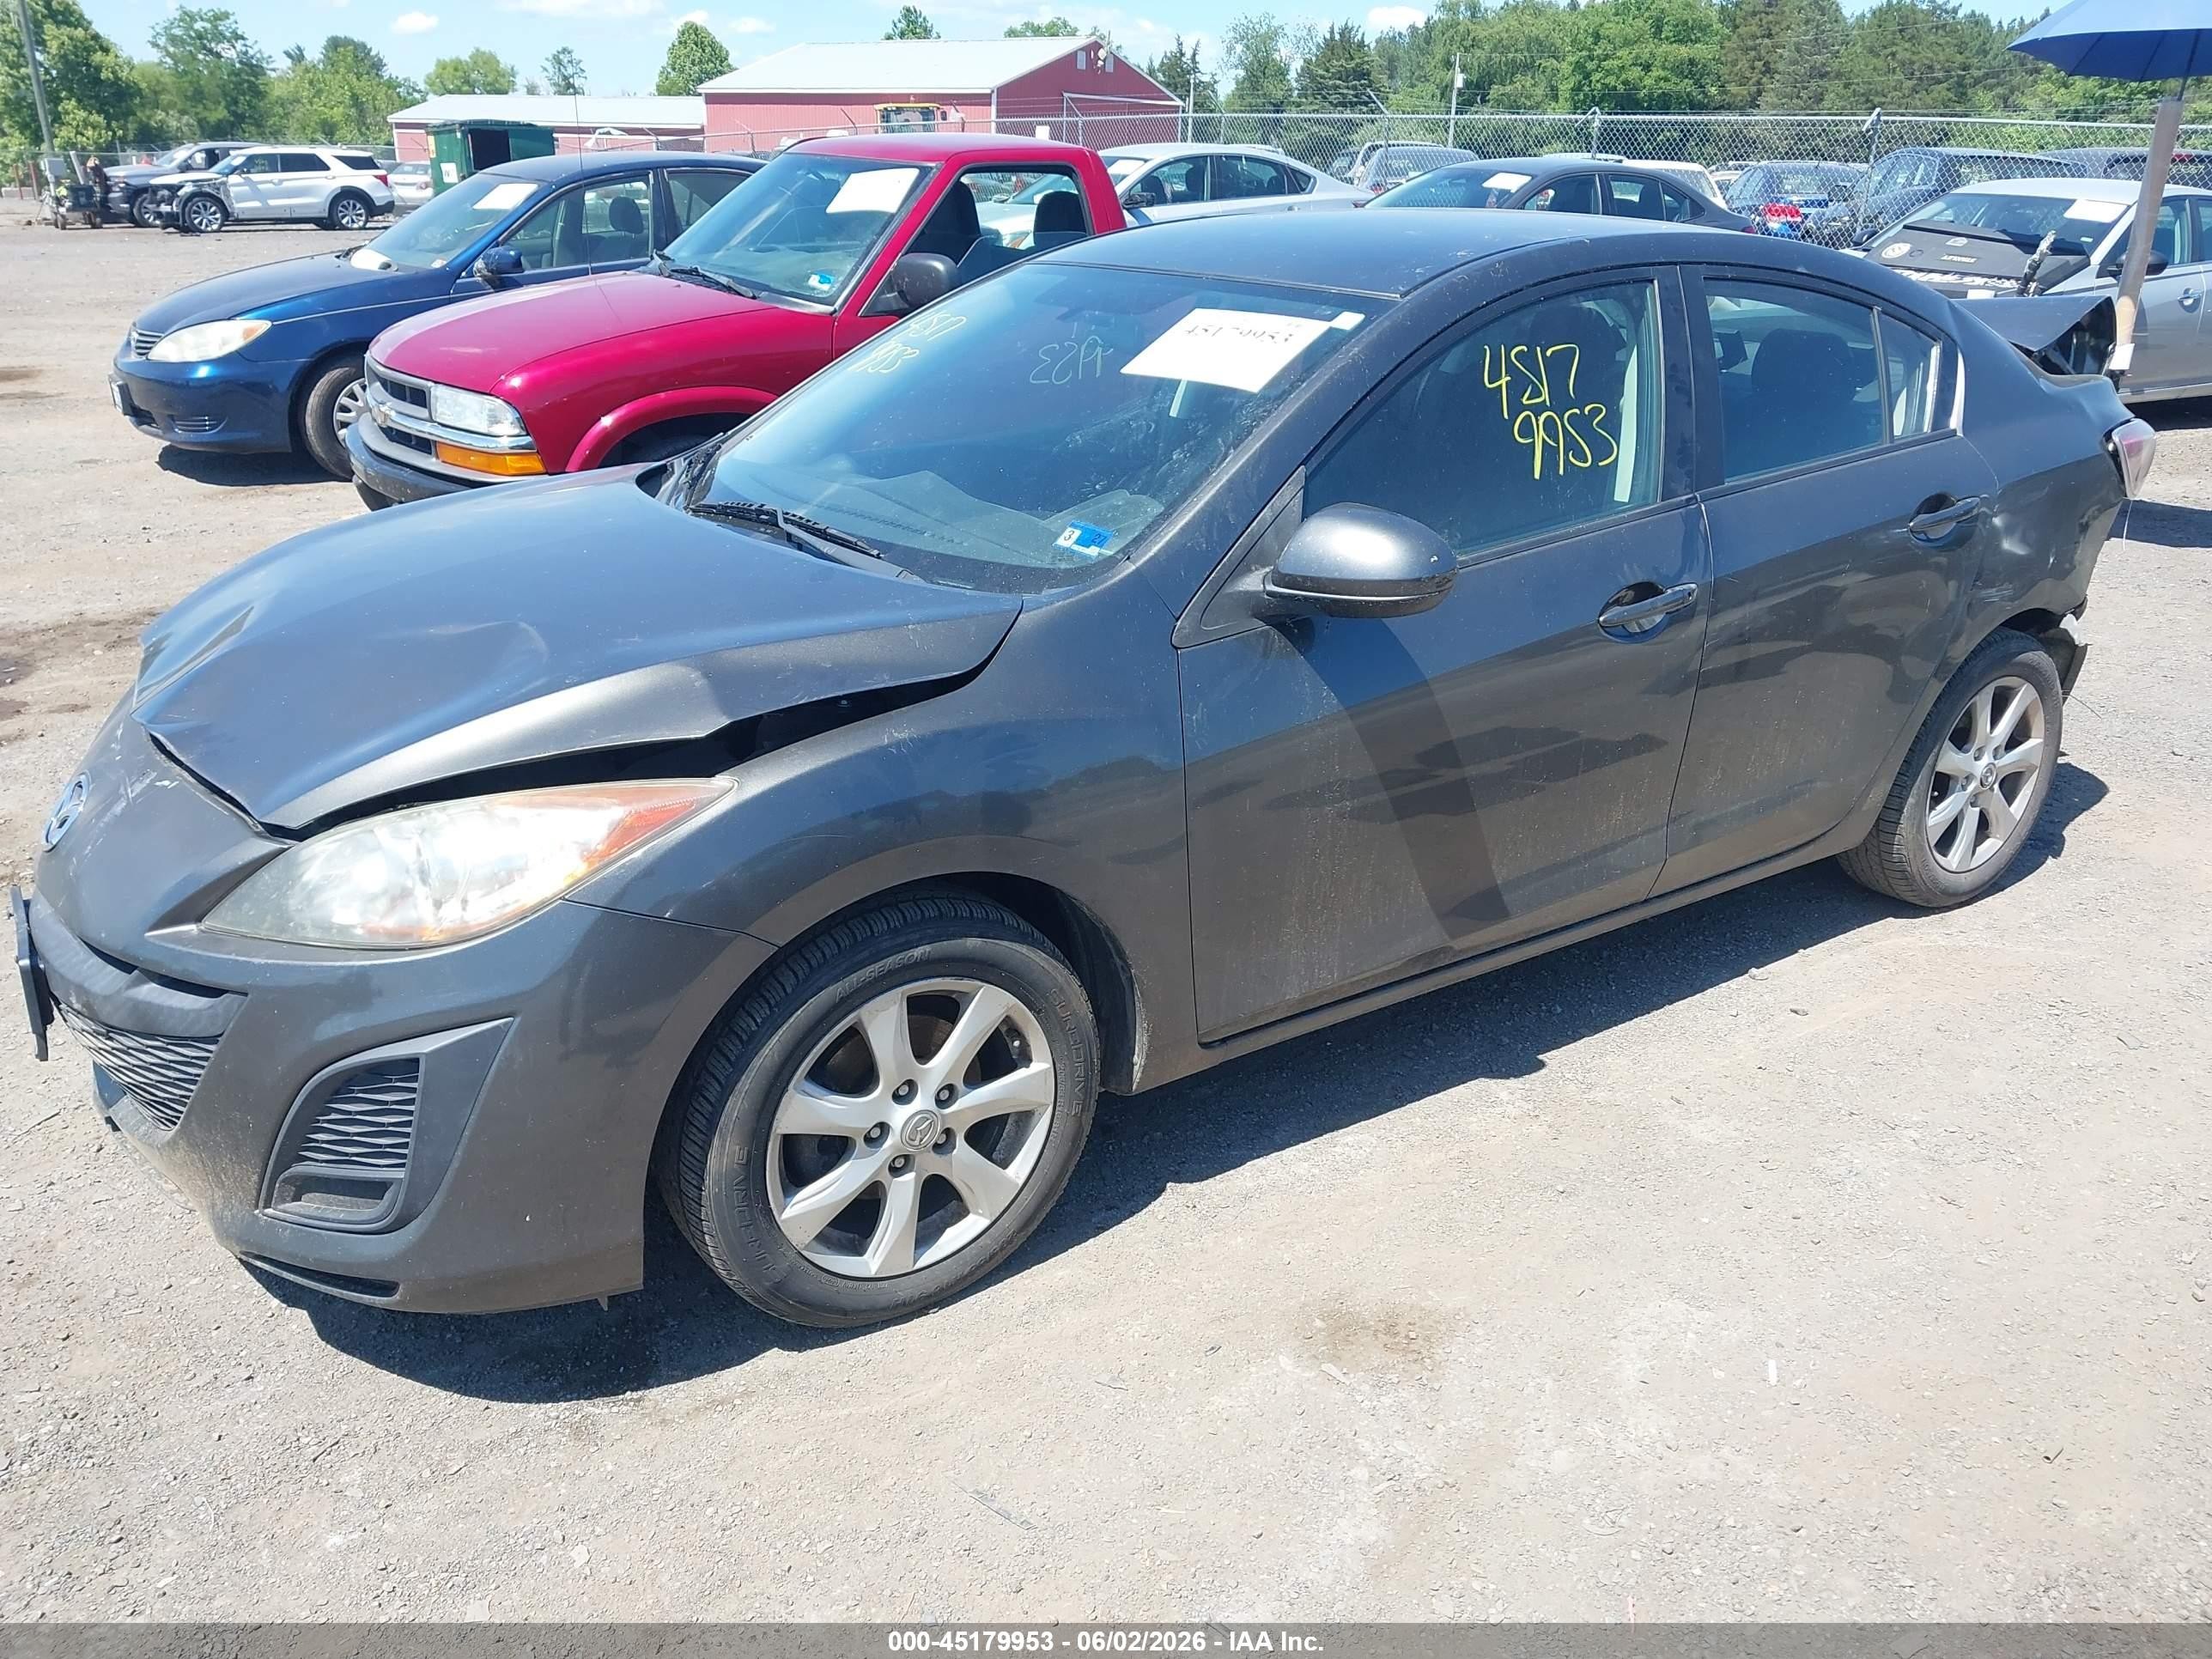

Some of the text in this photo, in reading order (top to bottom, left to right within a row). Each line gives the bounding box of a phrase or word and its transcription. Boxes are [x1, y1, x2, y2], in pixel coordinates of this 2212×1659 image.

[1483, 343, 1580, 419] 4517
[1513, 403, 1619, 480] 9953
[1064, 531, 1075, 541] 3
[835, 946, 933, 1005] ALL-SEASON
